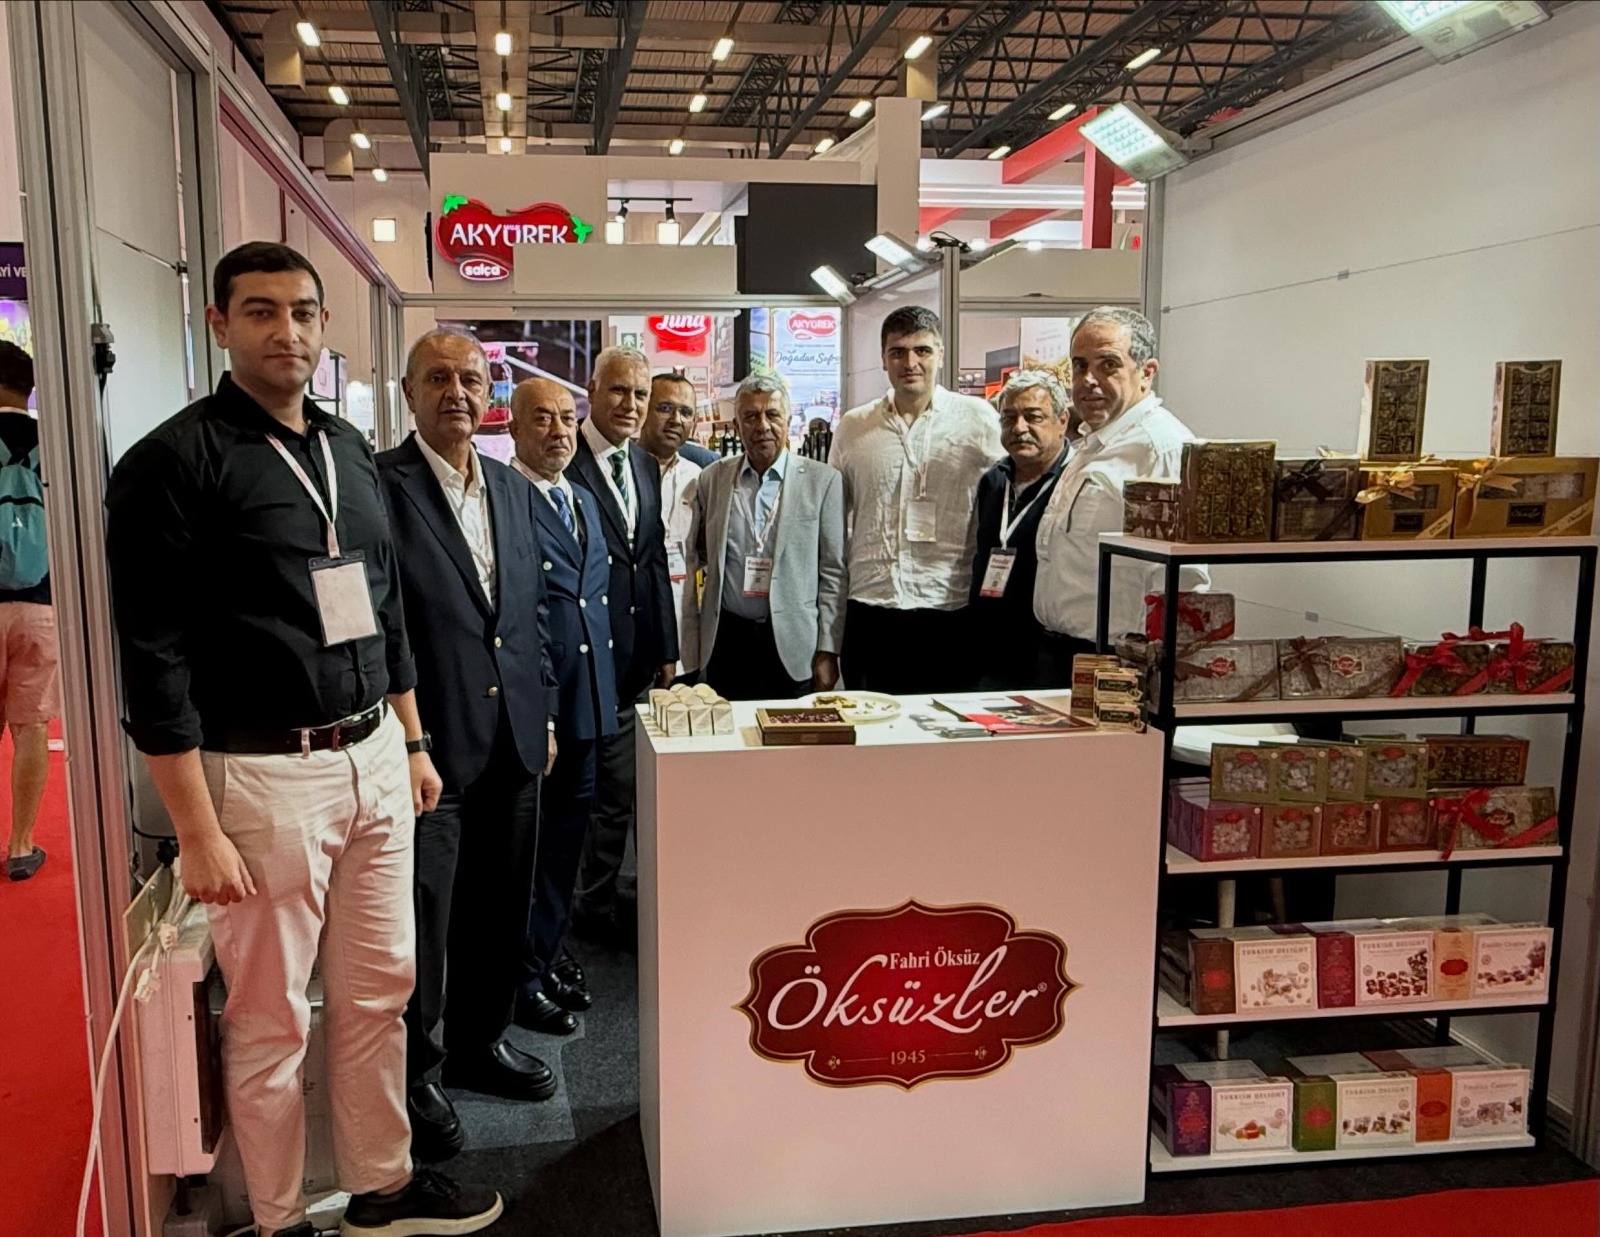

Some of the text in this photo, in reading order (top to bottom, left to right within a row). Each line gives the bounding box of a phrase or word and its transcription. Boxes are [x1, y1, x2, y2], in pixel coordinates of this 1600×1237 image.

[0, 263, 11, 278] Yİ
[464, 263, 501, 277] salça
[889, 946, 980, 970] Fahri Öksüz
[767, 945, 1040, 1034] Öksüzler
[890, 1050, 926, 1065] 1945
